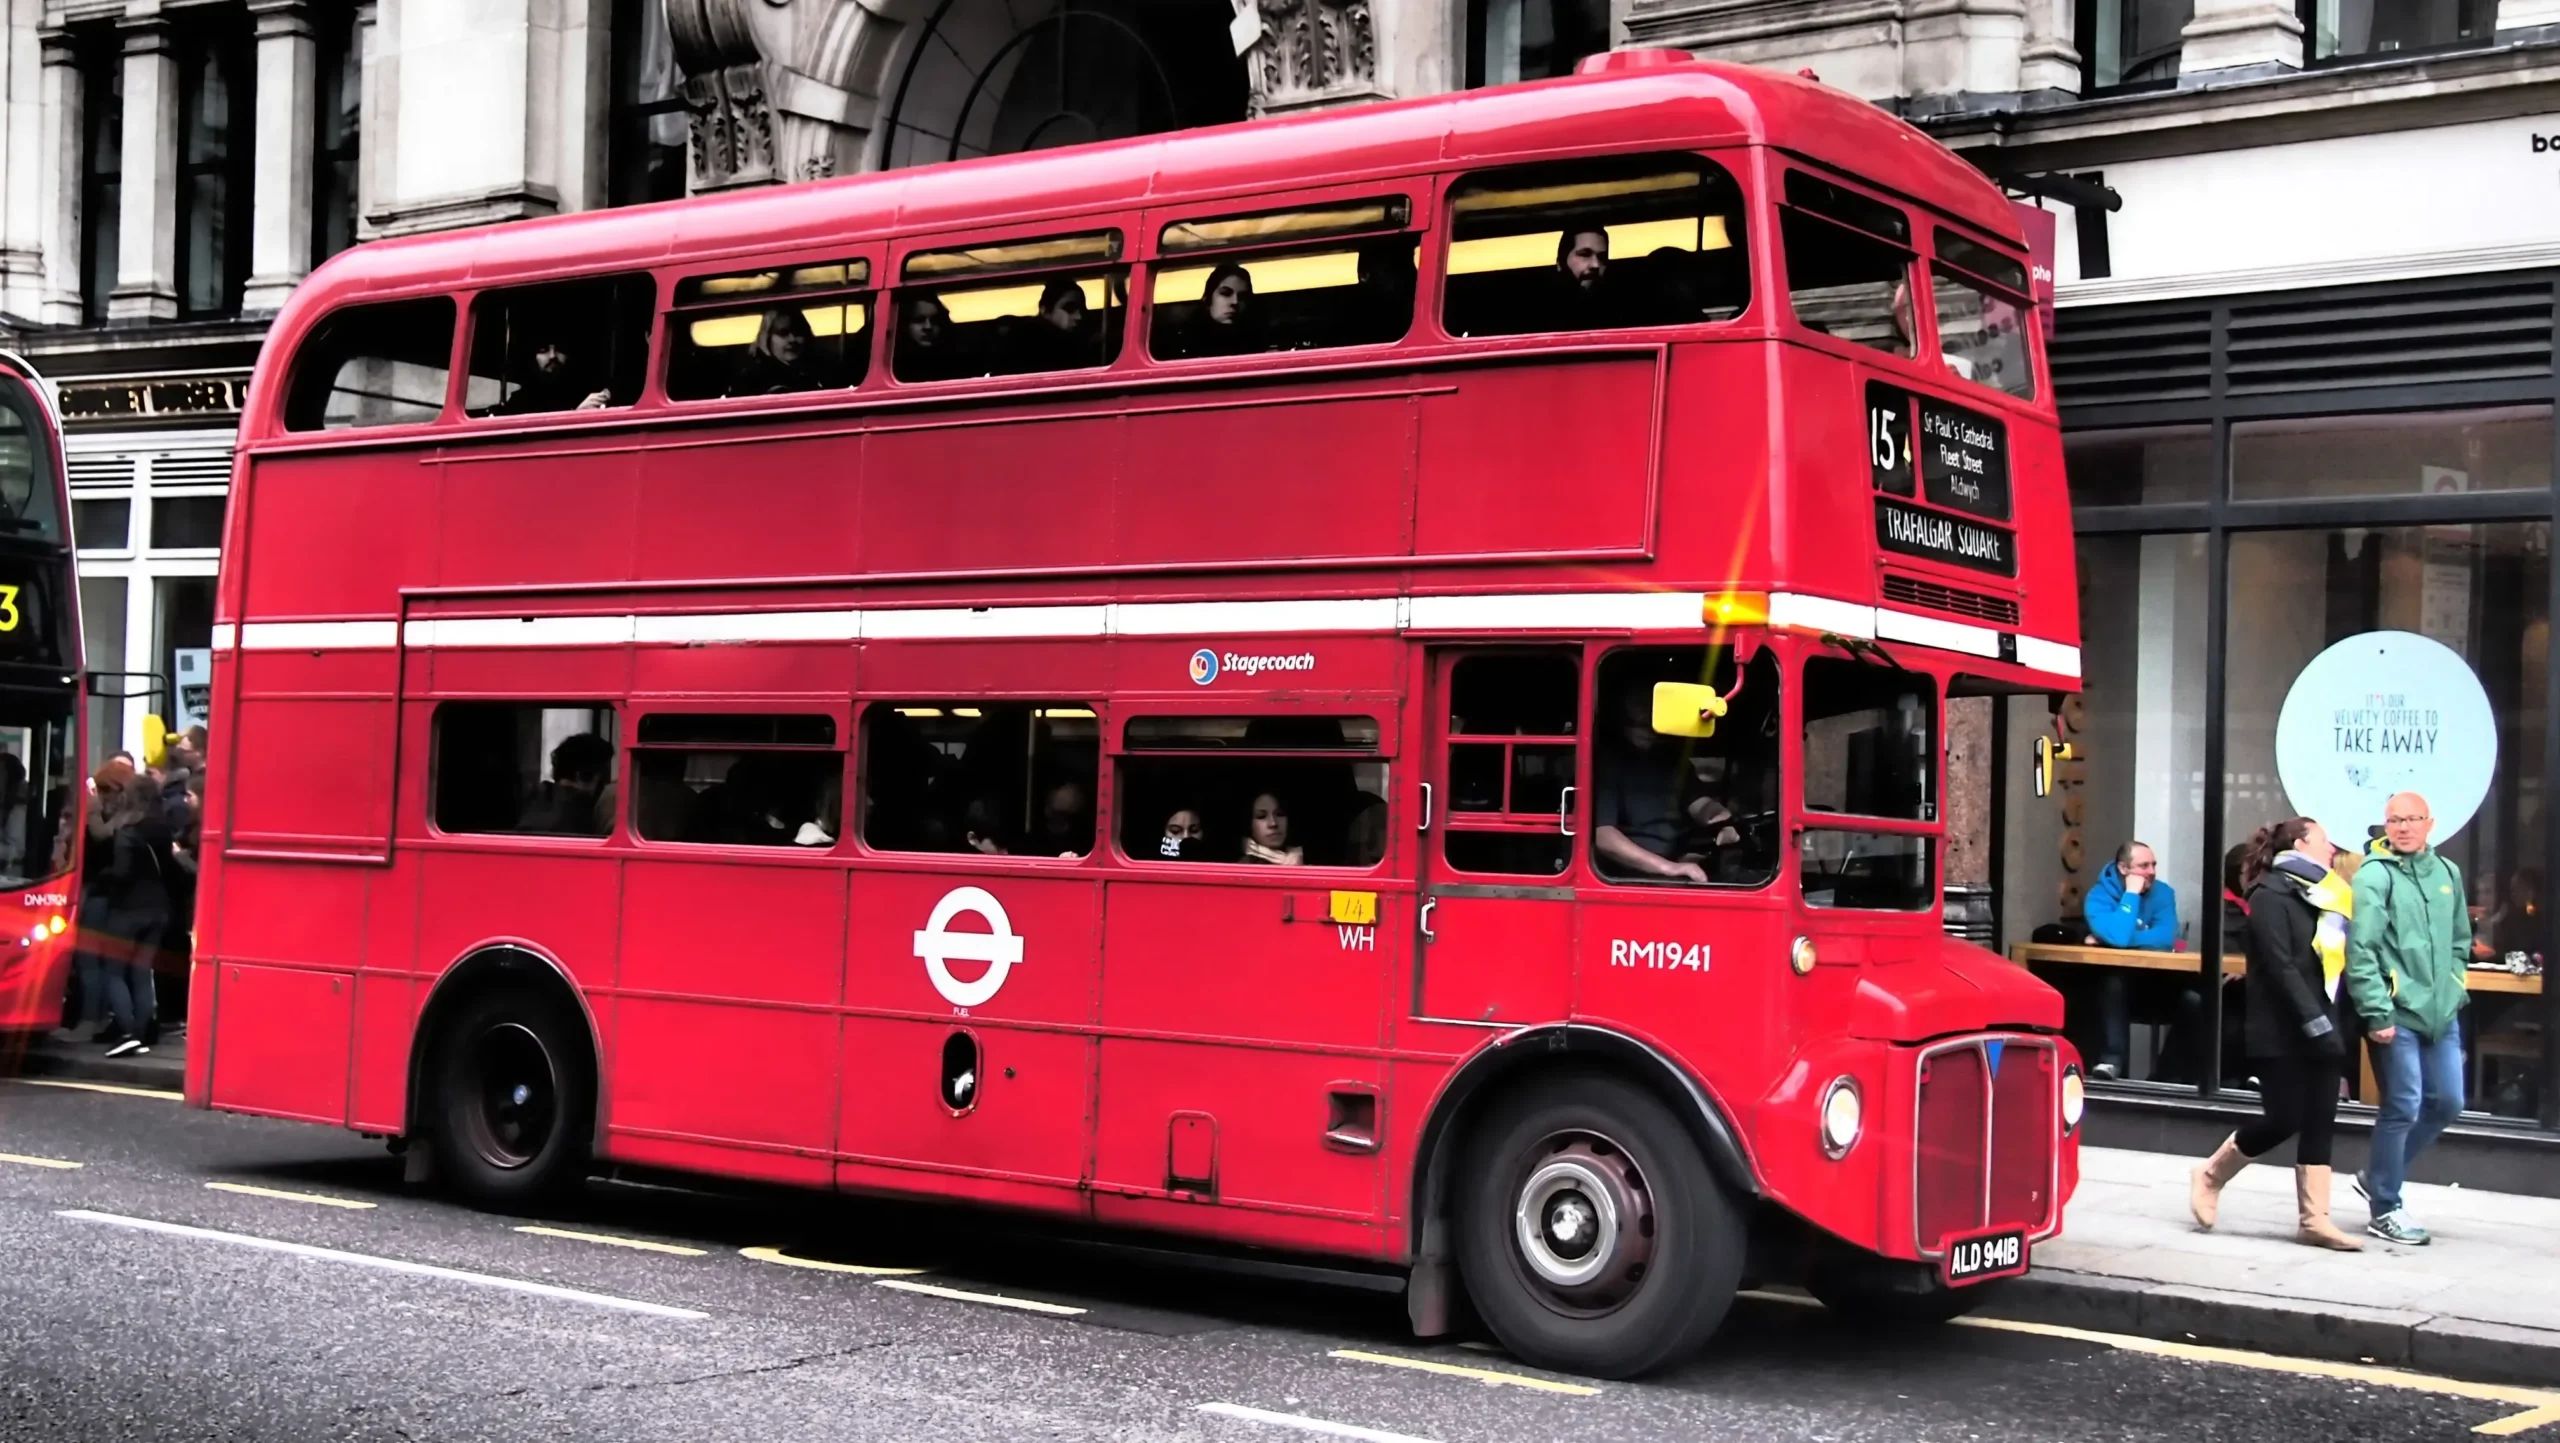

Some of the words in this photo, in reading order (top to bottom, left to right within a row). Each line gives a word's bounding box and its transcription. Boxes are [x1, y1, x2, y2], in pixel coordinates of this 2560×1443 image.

[1871, 407, 1896, 470] 15
[1935, 414, 1960, 441] Paul's
[1960, 422, 1995, 452] Cathedral
[1940, 443, 1960, 469] Fleet
[1961, 450, 1984, 475] Street
[1950, 474, 1980, 504] Aldwych
[1886, 506, 1954, 552] TRAFALGAR
[1957, 522, 2002, 562] SQUARE
[1222, 652, 1315, 676] Stagecoach
[2388, 693, 2405, 707] OUR
[2334, 709, 2379, 726] VELVETY
[2383, 709, 2420, 726] COFFEE
[2425, 709, 2438, 726] TO
[2334, 727, 2374, 753] TAKE
[2381, 728, 2438, 754] AWAY
[1338, 924, 1374, 952] WH
[1611, 938, 1710, 972] RM1941
[1951, 1243, 1981, 1275] ALD
[1983, 1236, 2019, 1268] 941B
